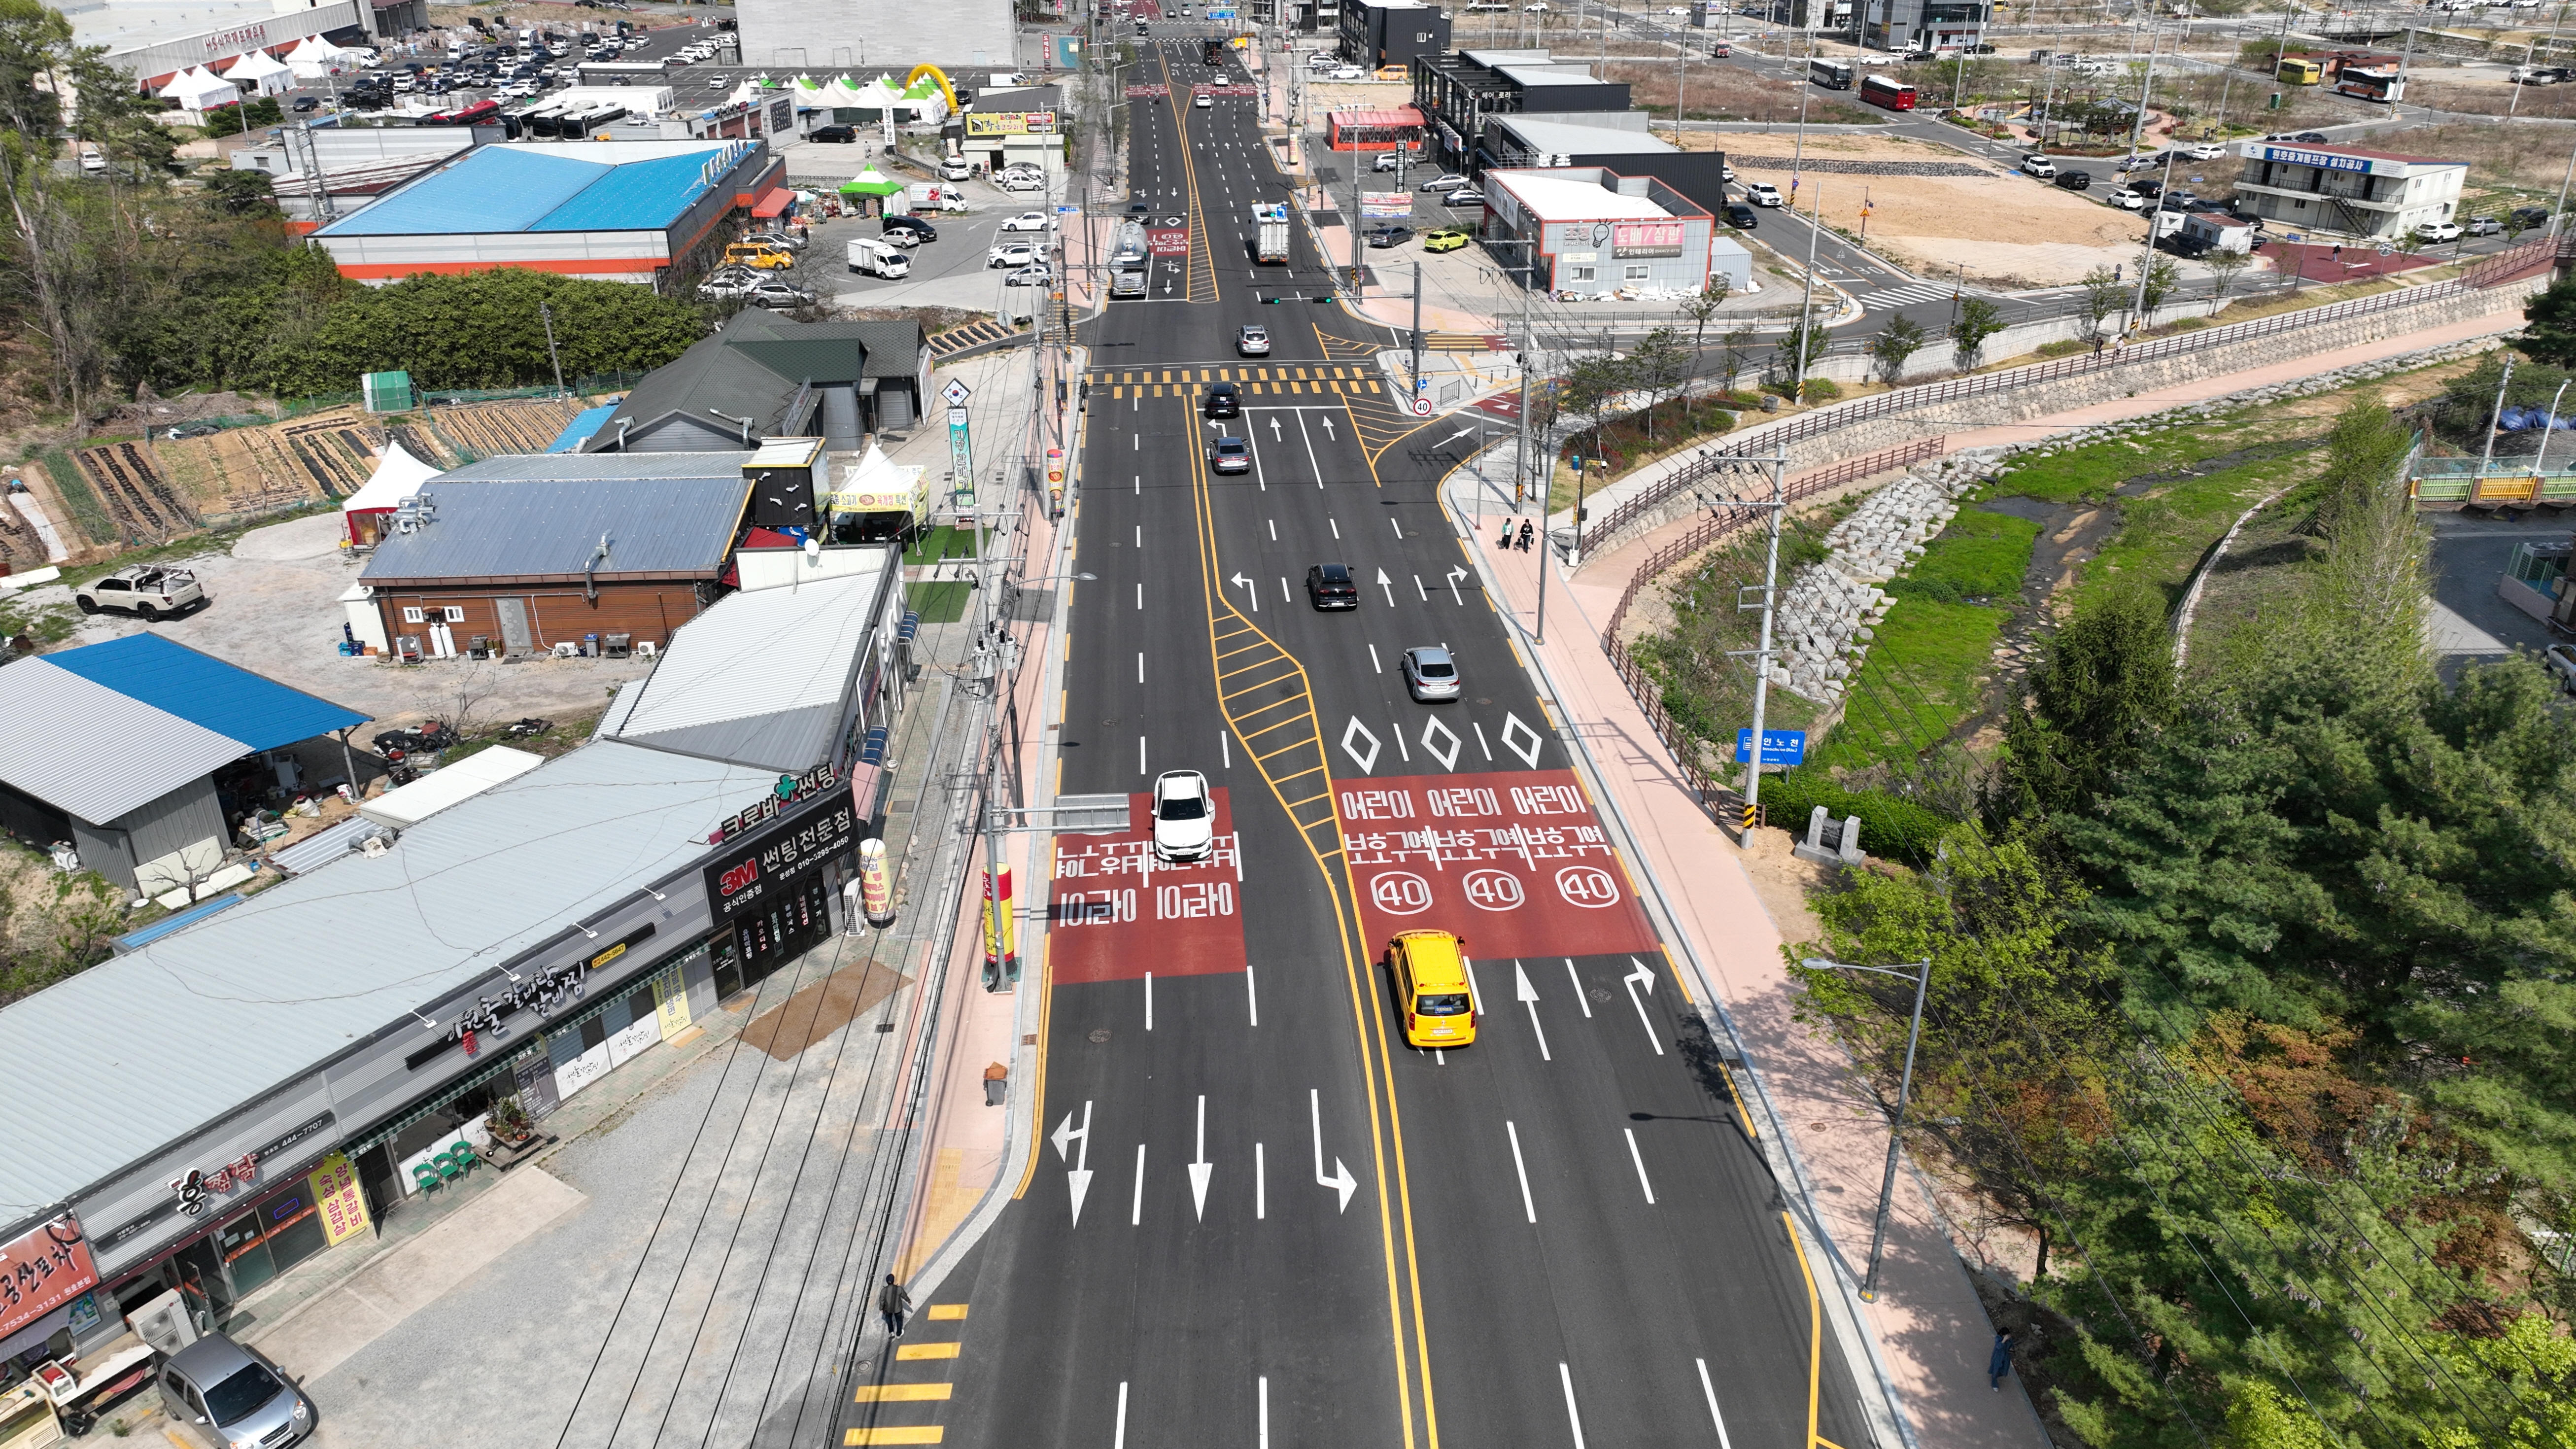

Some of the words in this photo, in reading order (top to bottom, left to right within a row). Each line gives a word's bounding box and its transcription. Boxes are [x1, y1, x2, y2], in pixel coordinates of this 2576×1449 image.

[2331, 157, 2364, 171] 설치공사
[841, 495, 857, 506] 소고기
[877, 495, 893, 506] 육개장
[895, 494, 906, 505] 특선
[1763, 737, 1799, 747] 인노천
[722, 794, 780, 842] 크로바
[797, 762, 836, 800] 썬팅
[1341, 790, 1416, 820] 어린이
[1427, 788, 1502, 817] 어린이
[1510, 785, 1587, 815] 어린이
[720, 857, 759, 897] 3M
[762, 807, 851, 873] 썬팅전문점
[779, 866, 795, 881] 문성점
[797, 835, 849, 870] 010-3295-4050
[1343, 830, 1435, 864] 보호구역
[1432, 827, 1527, 862] 보호구역
[1522, 825, 1612, 859] 보호구역
[722, 884, 762, 913] 공식인증점
[1059, 888, 1136, 928] 어린이
[1156, 882, 1234, 920] 어린이
[1378, 879, 1425, 906] 40
[1471, 877, 1518, 902] 40
[1564, 874, 1612, 899] 40
[756, 919, 768, 952] 카오디오
[601, 945, 624, 962] 442-5647
[529, 961, 585, 1018] 갈비찜
[281, 1119, 323, 1147] 444-7707
[319, 1173, 336, 1199] 숙성
[335, 1162, 363, 1227] 양념통갈비
[327, 1199, 347, 1238] 삼겹살
[64, 1276, 92, 1298] 원호본점
